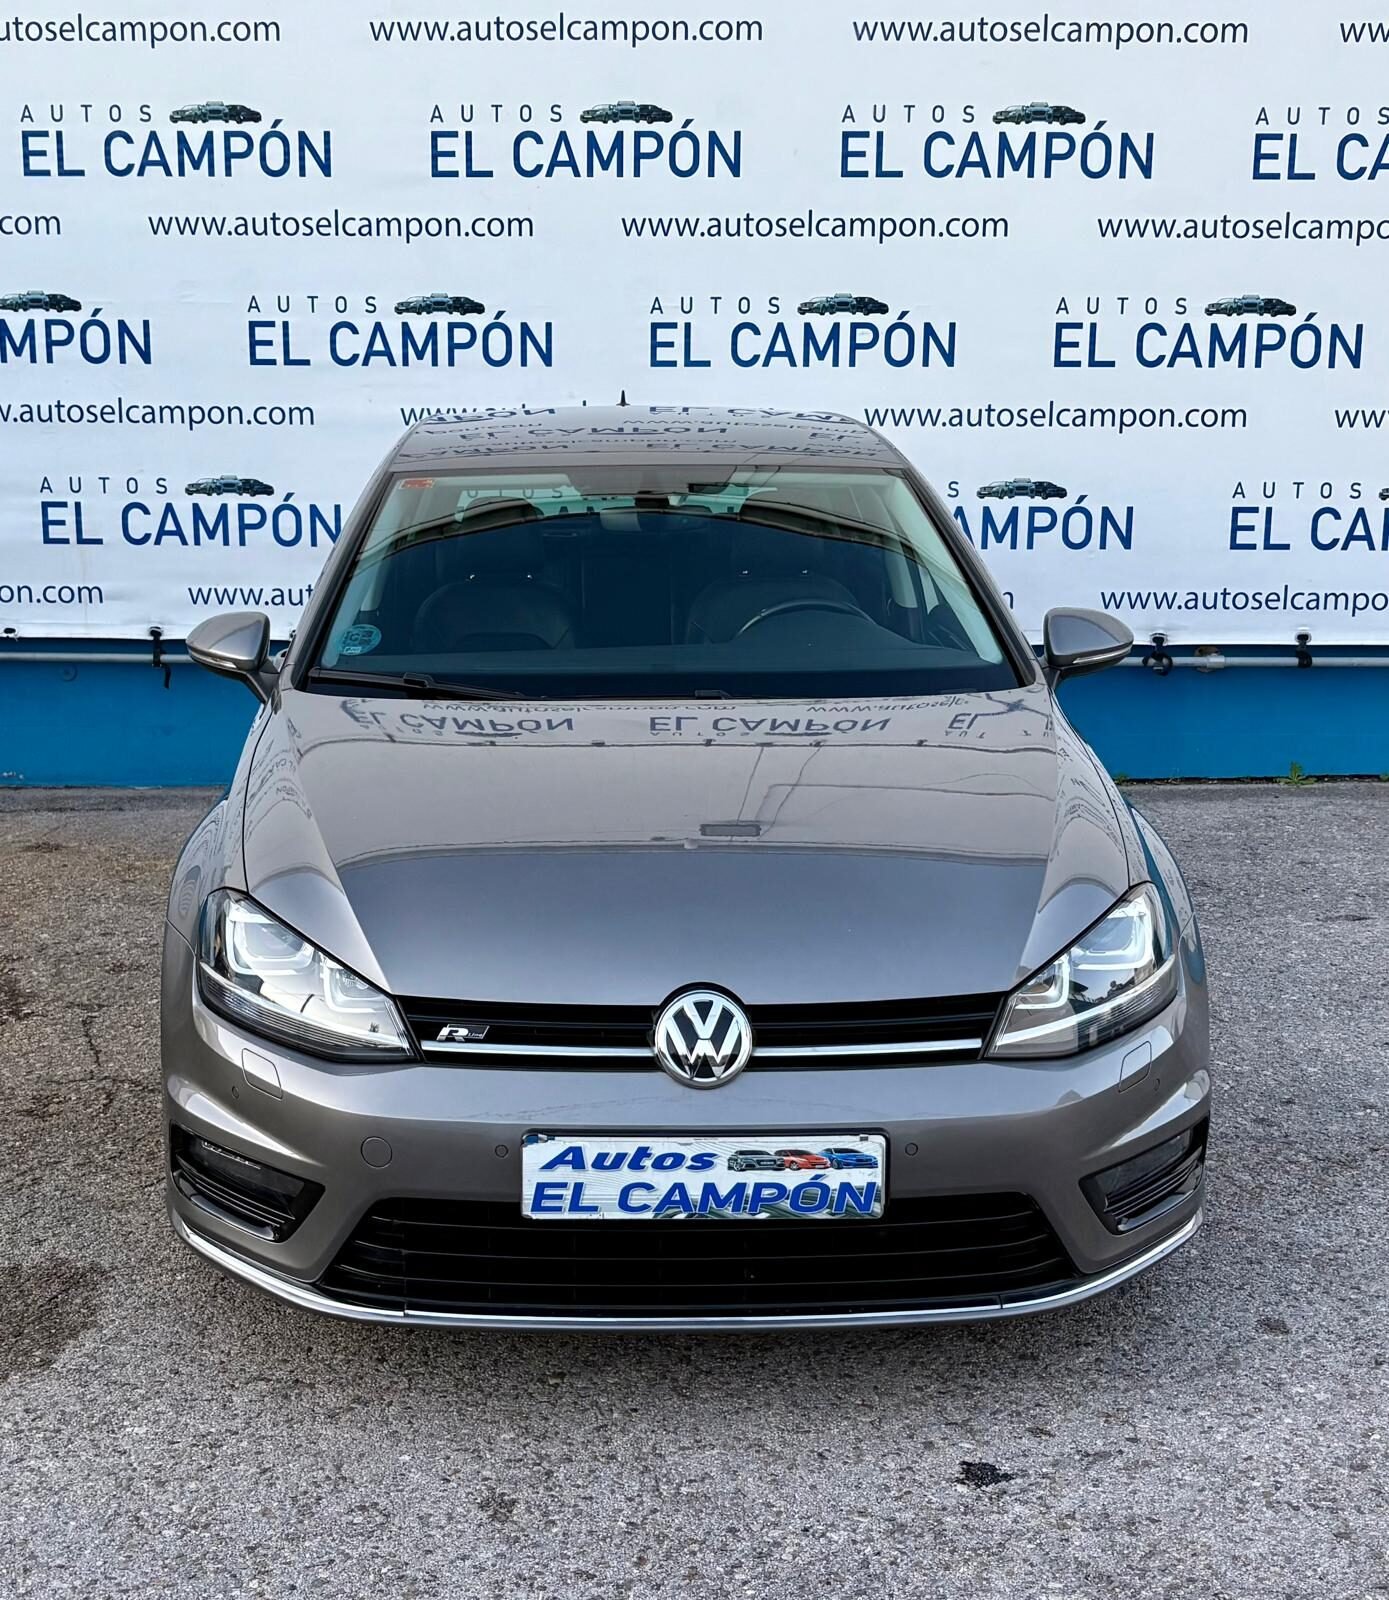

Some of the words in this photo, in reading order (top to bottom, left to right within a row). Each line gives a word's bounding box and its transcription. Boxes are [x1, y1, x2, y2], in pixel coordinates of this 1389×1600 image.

[370, 12, 762, 48] www.autoselcampon.com
[853, 14, 1247, 50] www.autoselcampon.com
[1340, 23, 1389, 42] ww
[21, 105, 151, 122] AUTOS
[430, 105, 562, 122] AUTOS
[842, 105, 974, 123] AUTOS
[1256, 107, 1389, 125] AUTOS
[22, 131, 85, 176] EL
[104, 119, 331, 177] CAMPÓN
[431, 131, 493, 177] EL
[513, 119, 741, 178] CAMPÓN
[841, 131, 903, 177] EL
[924, 120, 1154, 179] CAMPÓN
[1253, 133, 1315, 180] EL
[148, 209, 533, 244] www.autoselcampon.com
[622, 210, 1008, 244] www.autoselcampon.com
[248, 296, 376, 313] AUTOS
[650, 297, 779, 314] AUTOS
[1056, 297, 1186, 315] AUTOS
[0, 309, 151, 364] MPÓN
[248, 321, 311, 366] EL
[330, 311, 552, 367] CAMPÓN
[650, 322, 711, 367] EL
[731, 312, 956, 367] CAMPÓN
[1054, 322, 1115, 367] EL
[1136, 313, 1363, 369] CAMPÓN
[864, 402, 1246, 434] www.autoselcampon.com
[1335, 410, 1389, 428] ww
[40, 477, 167, 494] AUTOS
[1232, 482, 1361, 499] AUTOS
[41, 501, 103, 545] EL
[122, 492, 341, 547] CAMPÓN
[1230, 507, 1290, 550] EL
[1311, 507, 1389, 551] CA
[1101, 586, 1389, 617] www.autoselcampo
[436, 1027, 468, 1041] R
[539, 1145, 719, 1171] Autos
[530, 1182, 599, 1214] EL
[617, 1174, 876, 1214] CAMPÓN
